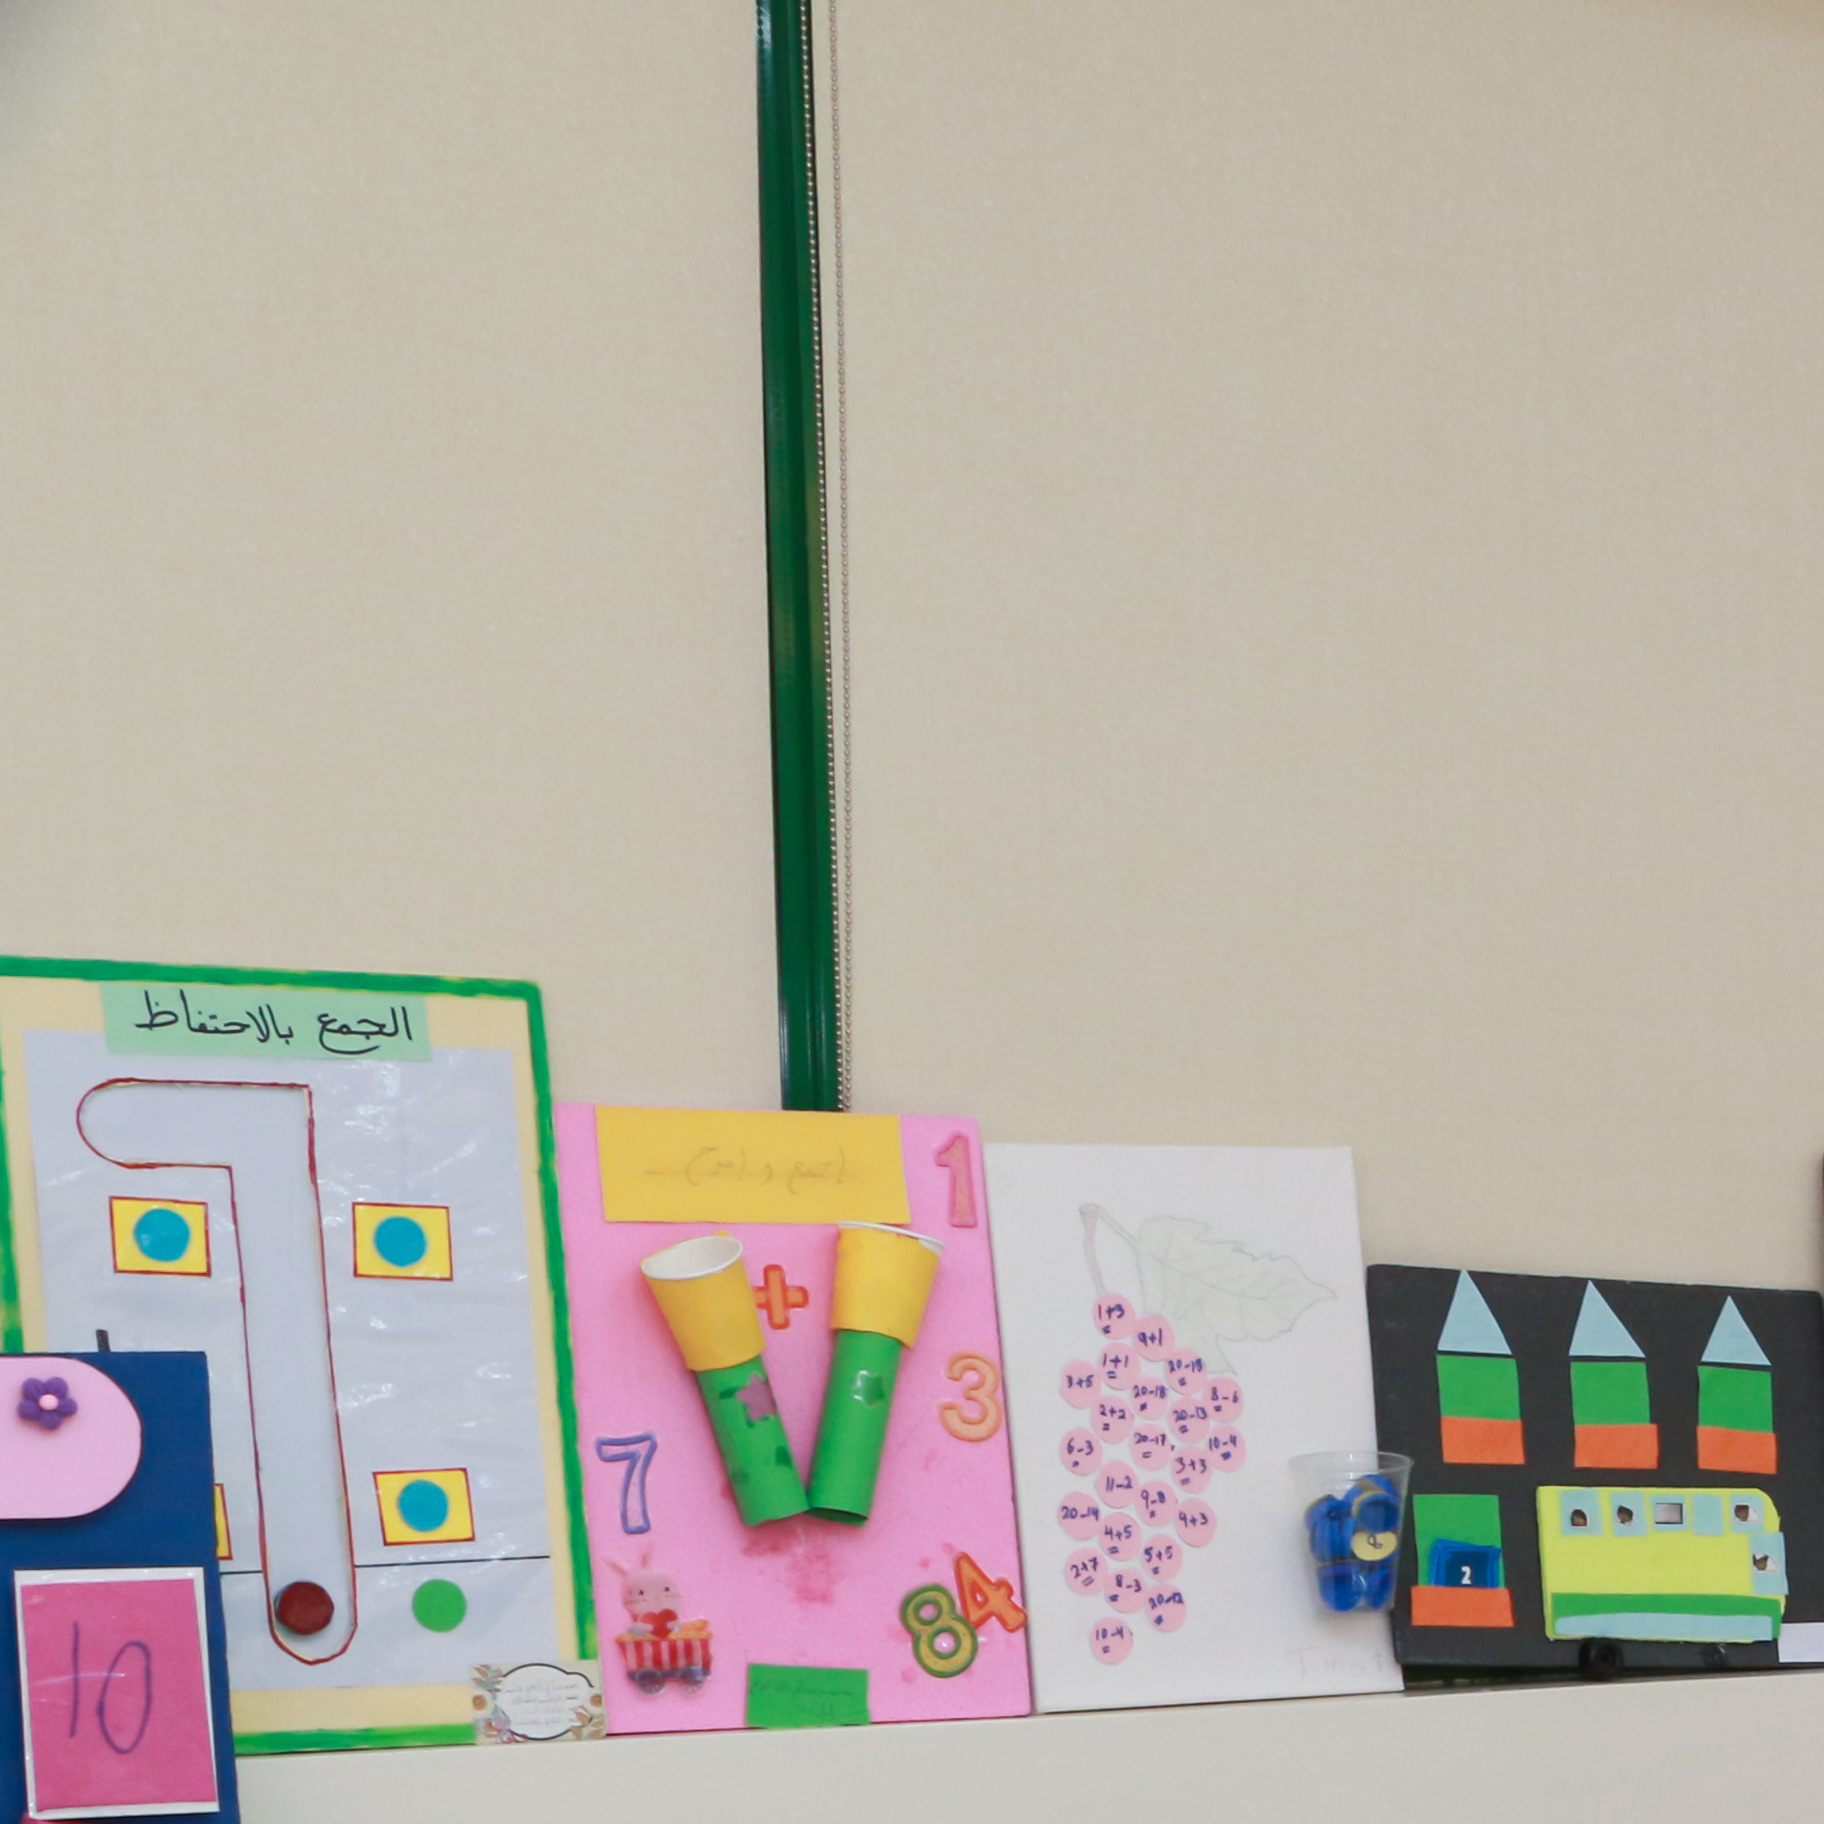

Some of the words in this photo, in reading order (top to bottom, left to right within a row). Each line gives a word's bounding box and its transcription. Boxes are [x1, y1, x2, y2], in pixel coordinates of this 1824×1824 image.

[135, 990, 294, 1044] بالاحتفاظ
[316, 1009, 413, 1055] الجمع
[936, 1133, 978, 1228] 1
[940, 1353, 1001, 1442] 3
[595, 1432, 658, 1535] 7
[953, 1551, 1028, 1633] 4
[1461, 1566, 1472, 1584] 2
[900, 1582, 979, 1680] 8
[69, 1621, 152, 1754] 10
